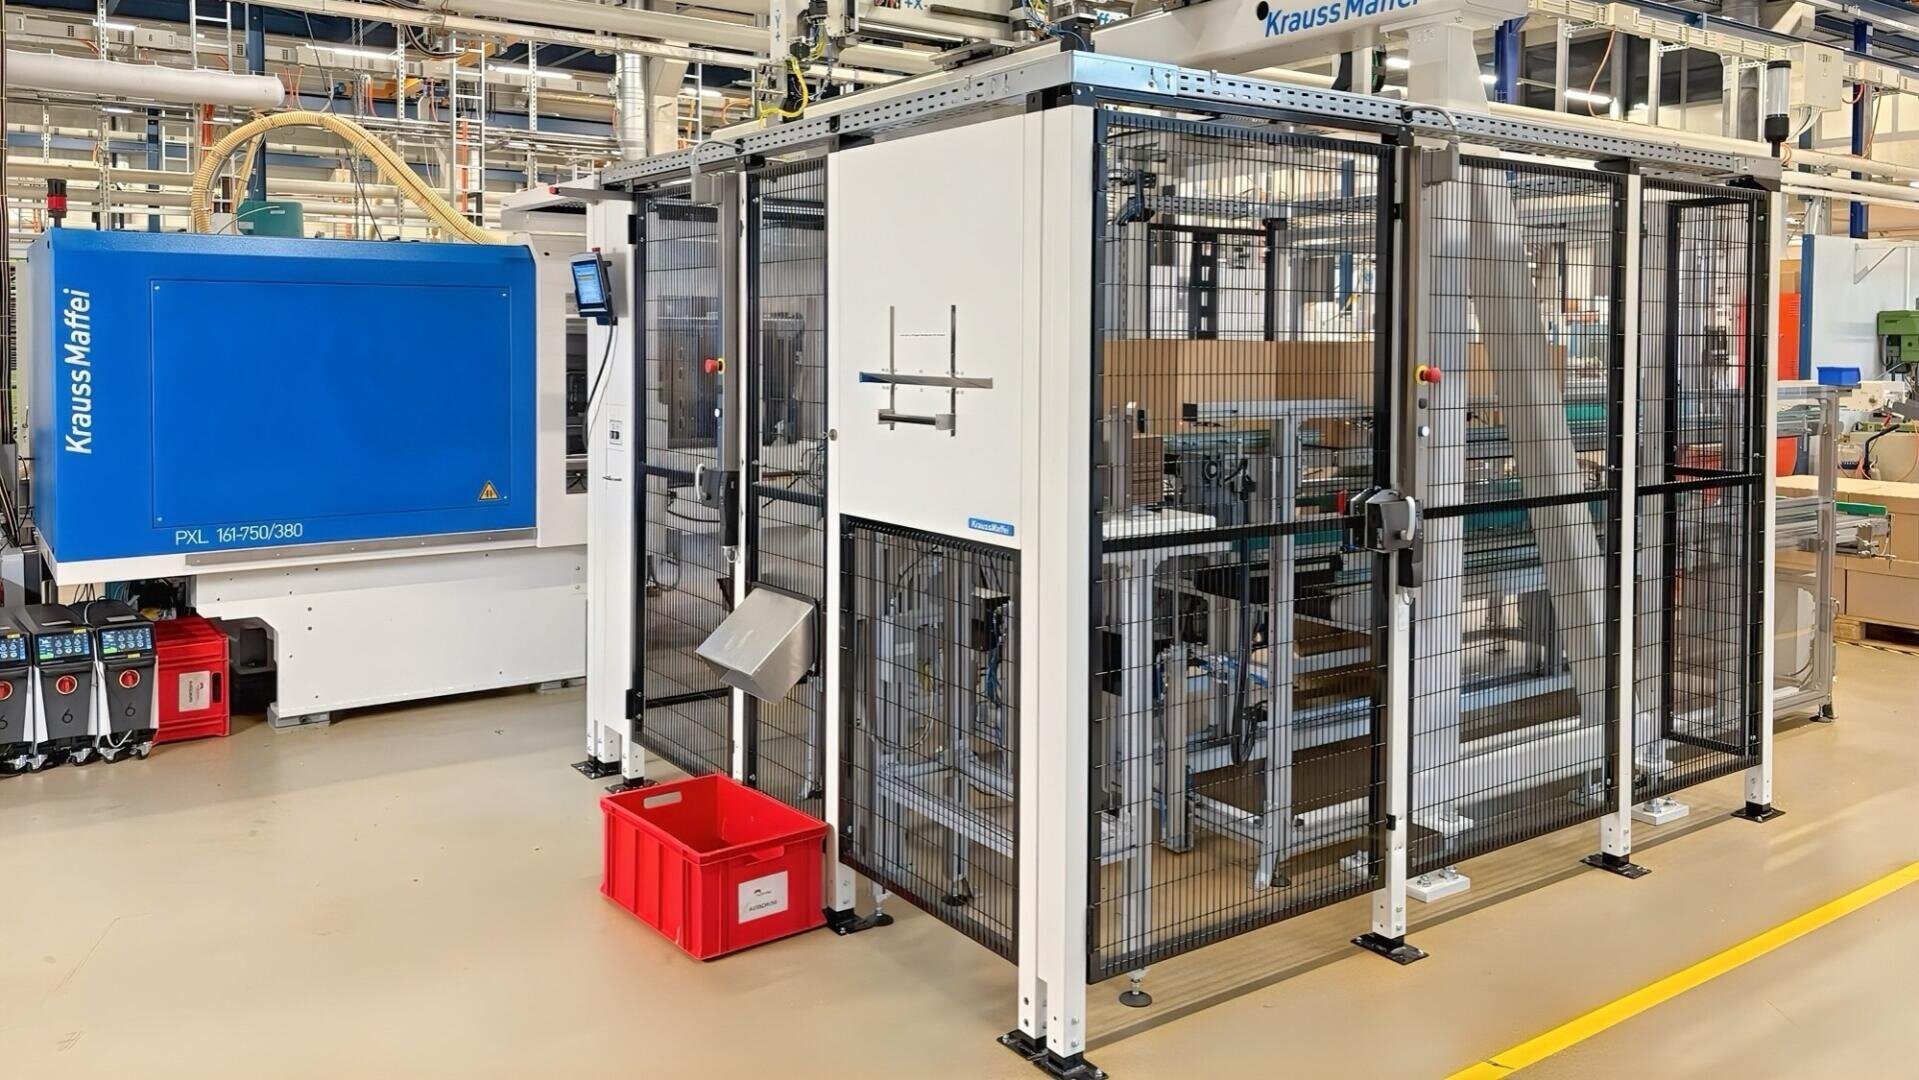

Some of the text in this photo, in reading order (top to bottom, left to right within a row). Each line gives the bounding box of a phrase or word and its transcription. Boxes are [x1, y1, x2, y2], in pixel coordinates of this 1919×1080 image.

[175, 522, 303, 546] PXL 161-750/380
[62, 707, 74, 724] 6
[124, 702, 136, 717] 6
